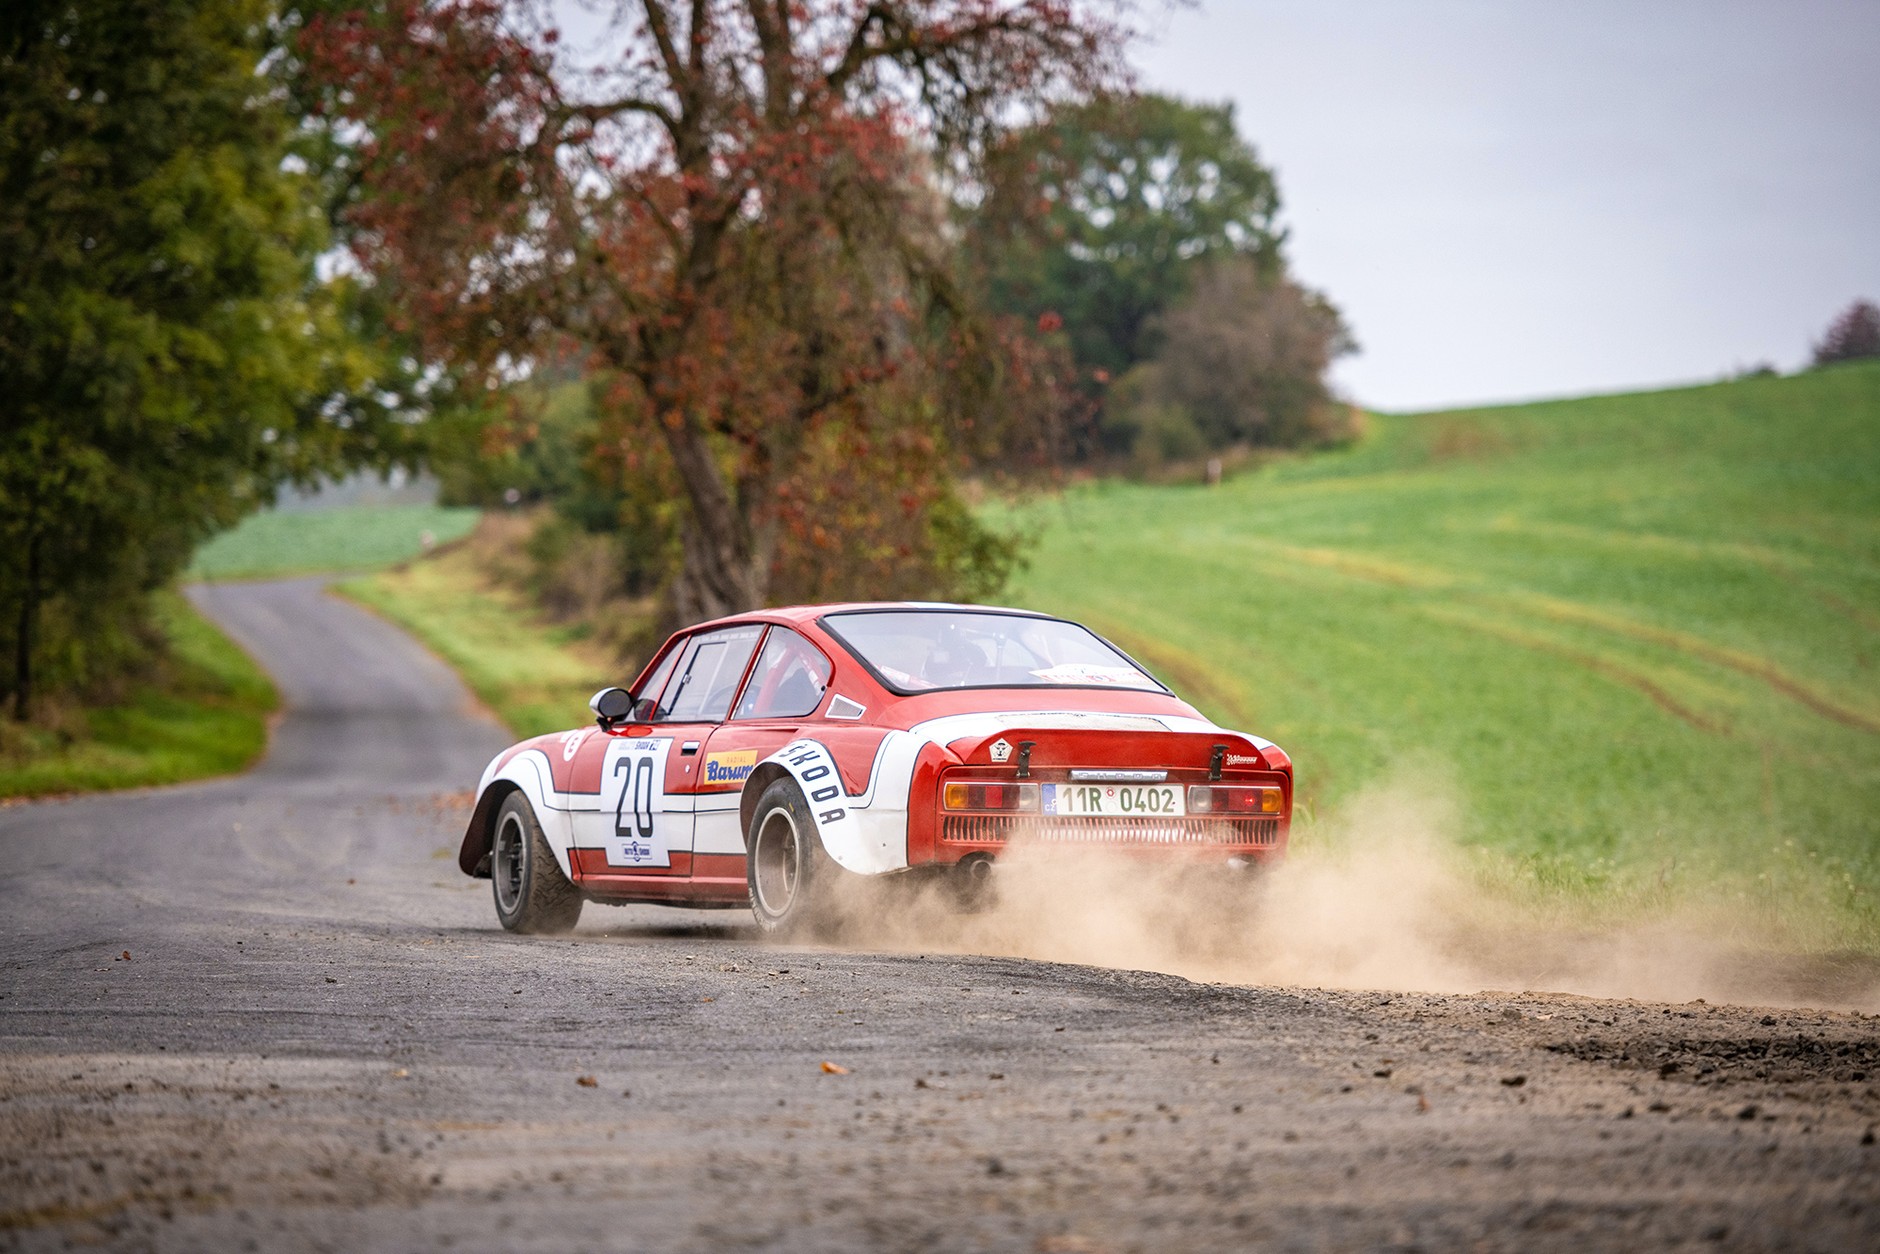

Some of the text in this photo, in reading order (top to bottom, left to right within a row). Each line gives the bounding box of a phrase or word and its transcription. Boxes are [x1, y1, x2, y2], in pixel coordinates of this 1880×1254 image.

[706, 760, 754, 781] Barum
[613, 756, 654, 838] 20
[1062, 787, 1175, 812] 11R 0402
